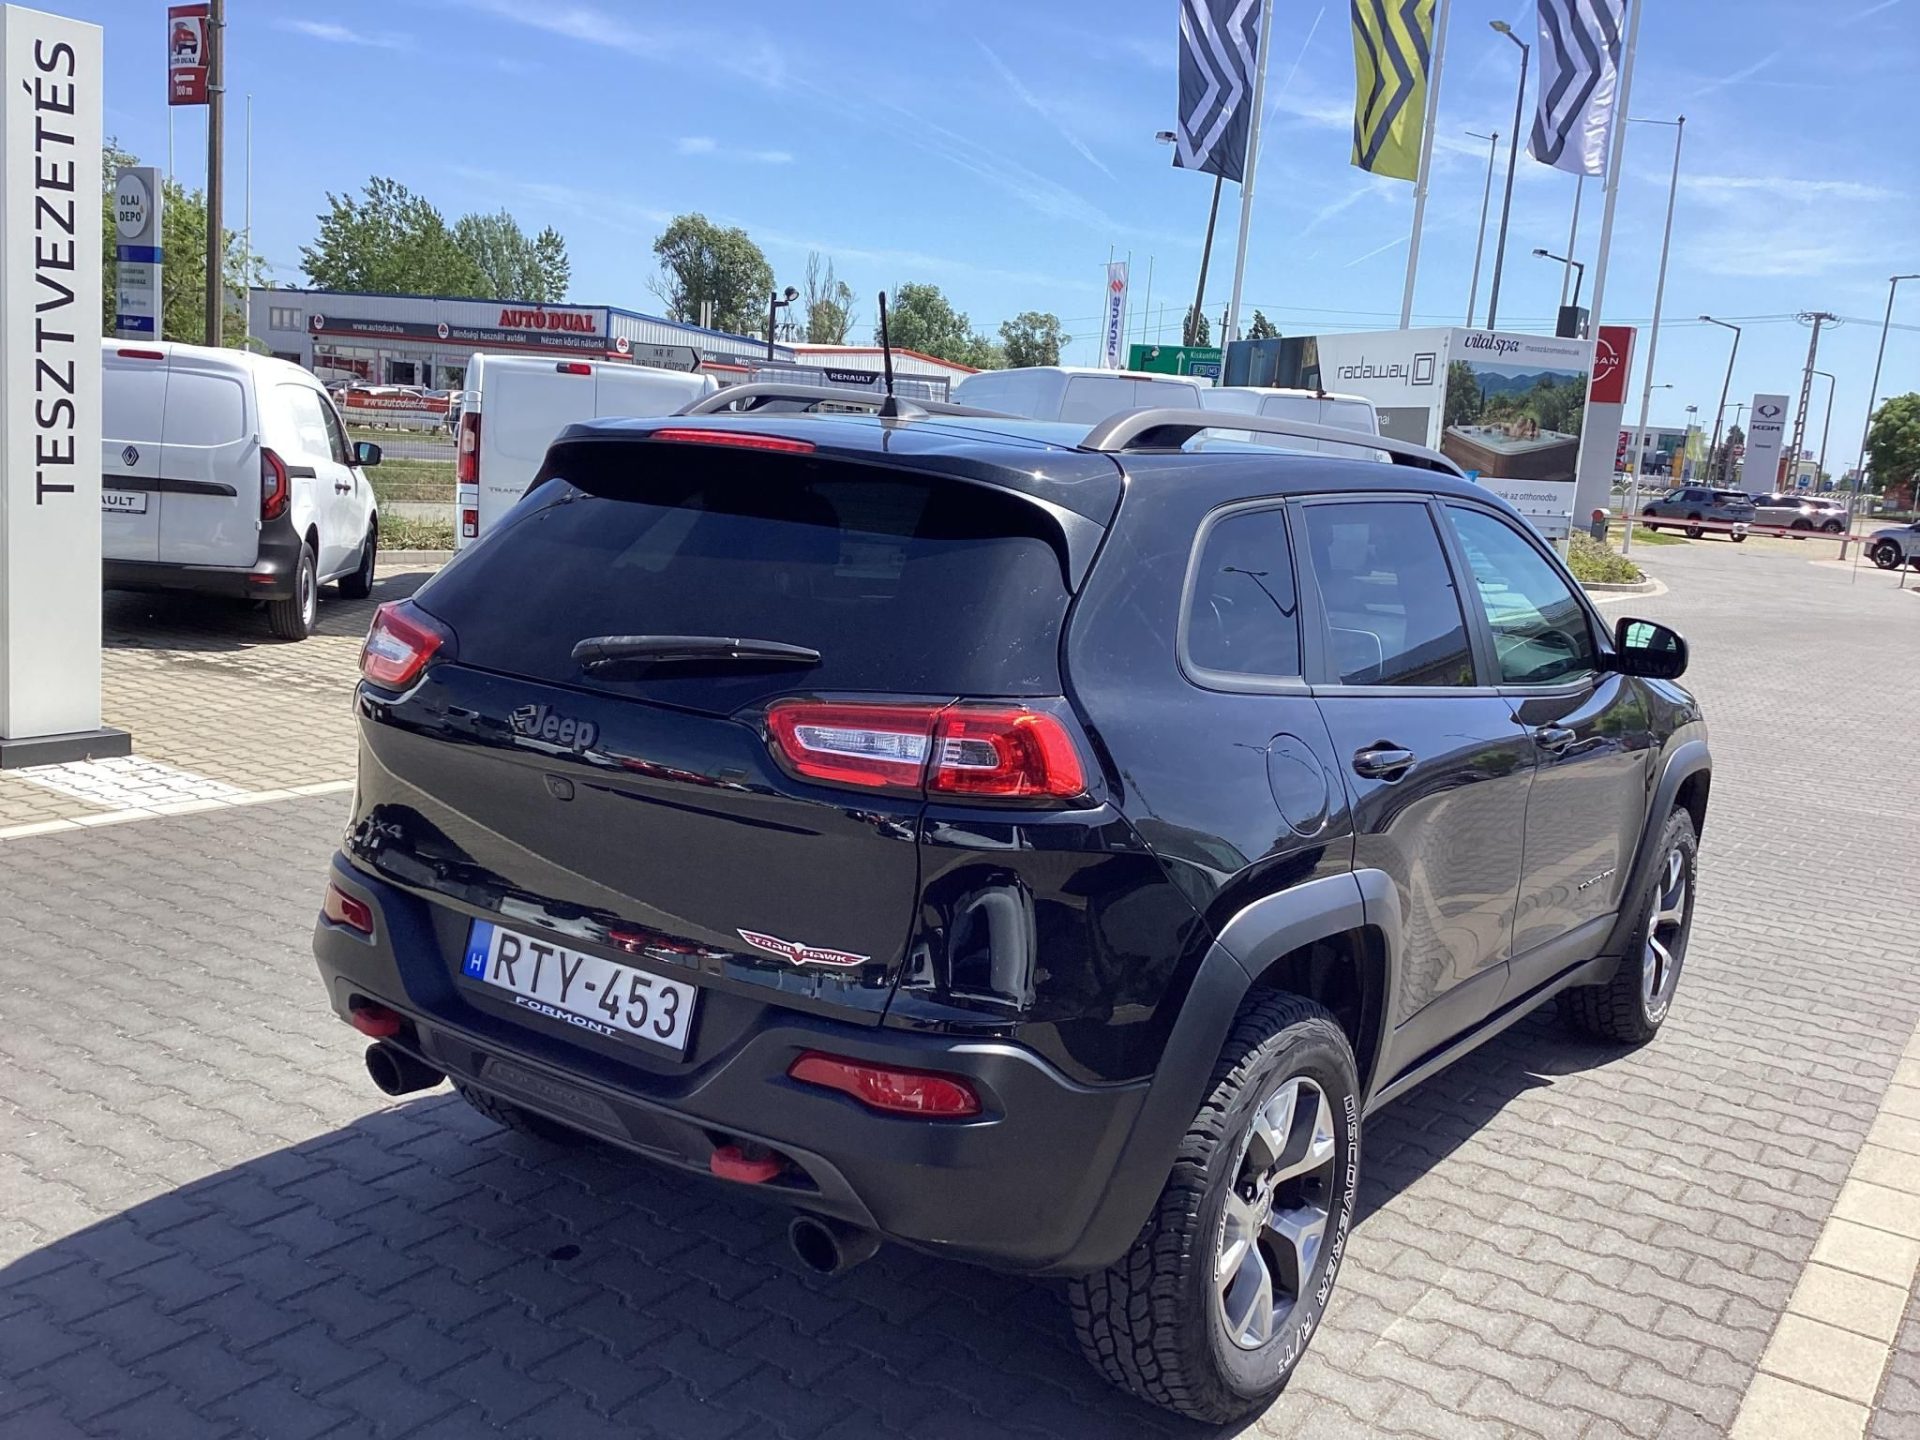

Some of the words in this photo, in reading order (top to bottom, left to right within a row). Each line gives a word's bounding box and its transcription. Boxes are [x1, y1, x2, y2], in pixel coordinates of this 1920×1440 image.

[120, 194, 140, 205] OLAJ
[119, 211, 142, 222] DEPO
[22, 39, 75, 505] TESZTVEZETÉS
[352, 323, 404, 334] www.autodual.hu
[498, 304, 546, 329] AUTÓ
[549, 312, 596, 333] DUAL
[540, 335, 563, 346] Nézzen
[830, 372, 872, 383] RENAULT
[1337, 355, 1410, 387] radaway
[524, 704, 595, 751] Jeep
[469, 954, 482, 972] H
[492, 931, 680, 1040] RTY-453
[515, 995, 616, 1036] FORMONT
[1316, 1094, 1359, 1307] DISCOVERER
